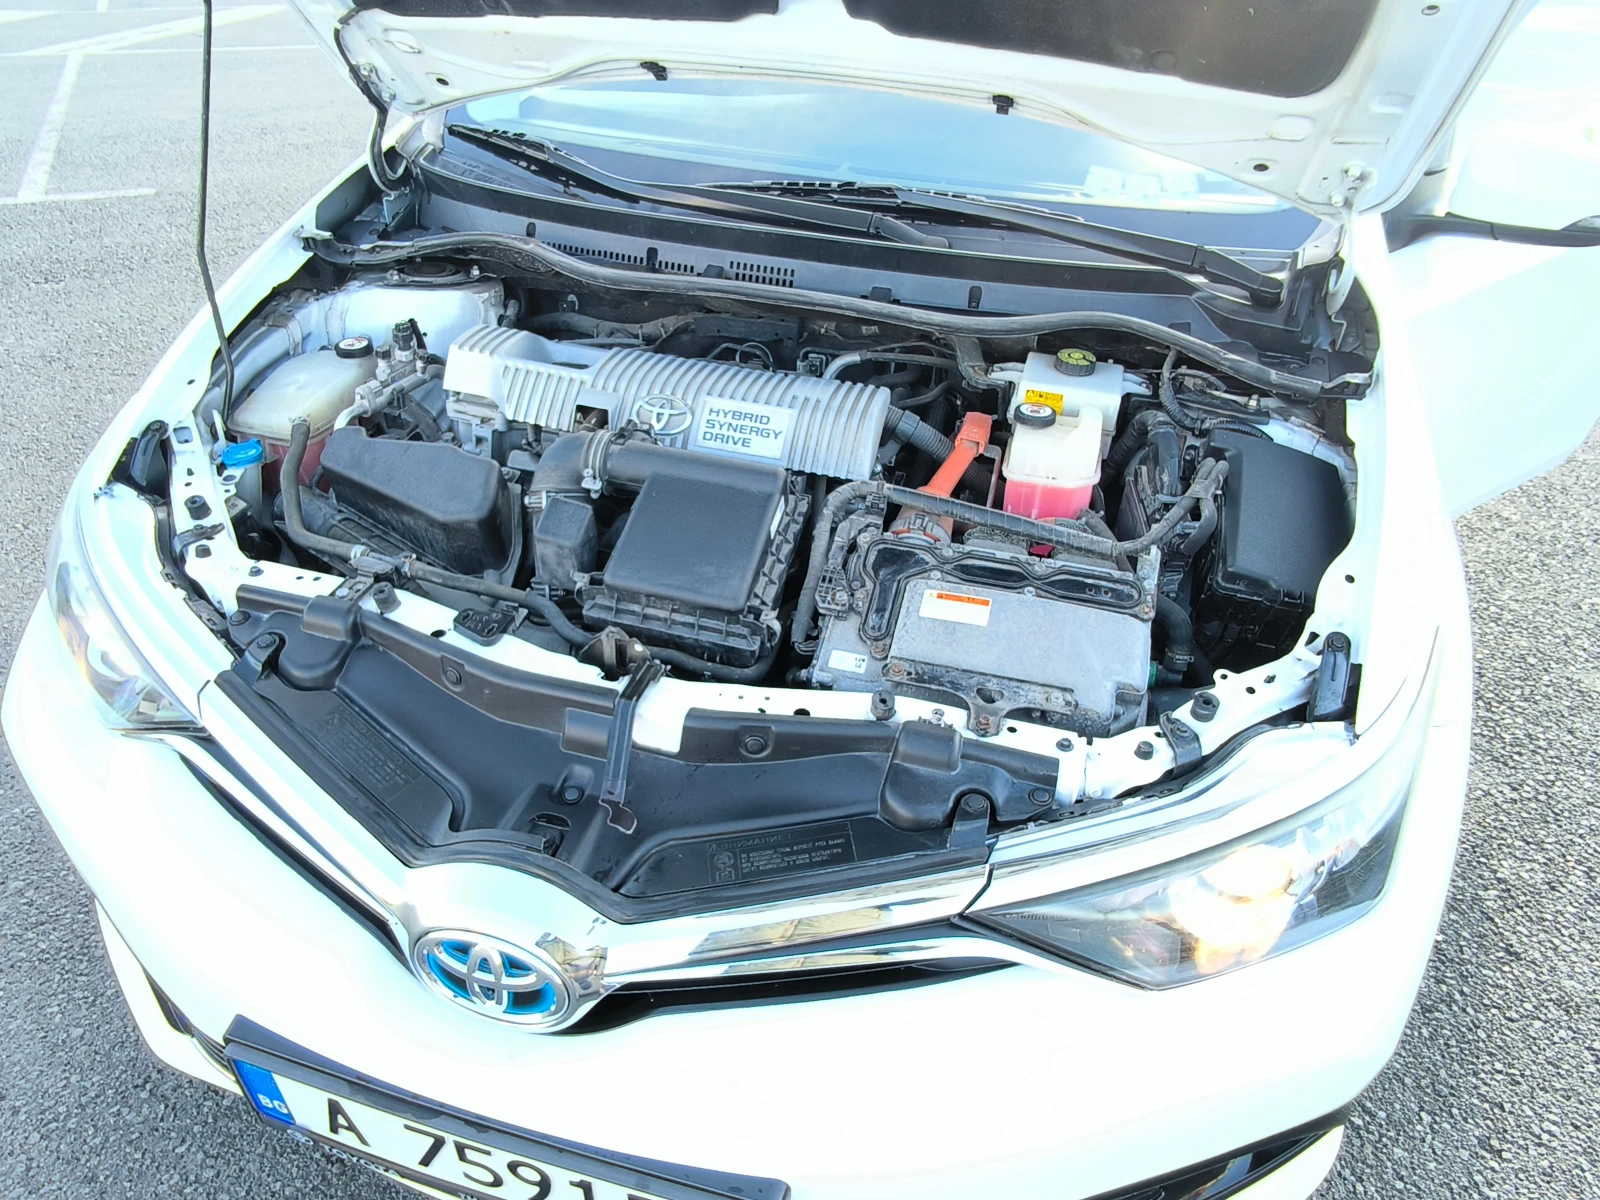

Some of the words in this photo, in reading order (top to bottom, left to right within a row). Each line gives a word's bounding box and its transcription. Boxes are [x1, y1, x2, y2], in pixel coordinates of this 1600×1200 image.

[709, 408, 770, 424] HYBRID
[704, 432, 751, 447] DRIVE
[705, 420, 782, 439] SYNERGY
[257, 1093, 289, 1114] BG
[328, 1098, 369, 1147] A
[319, 1143, 401, 1177] TOYOTA
